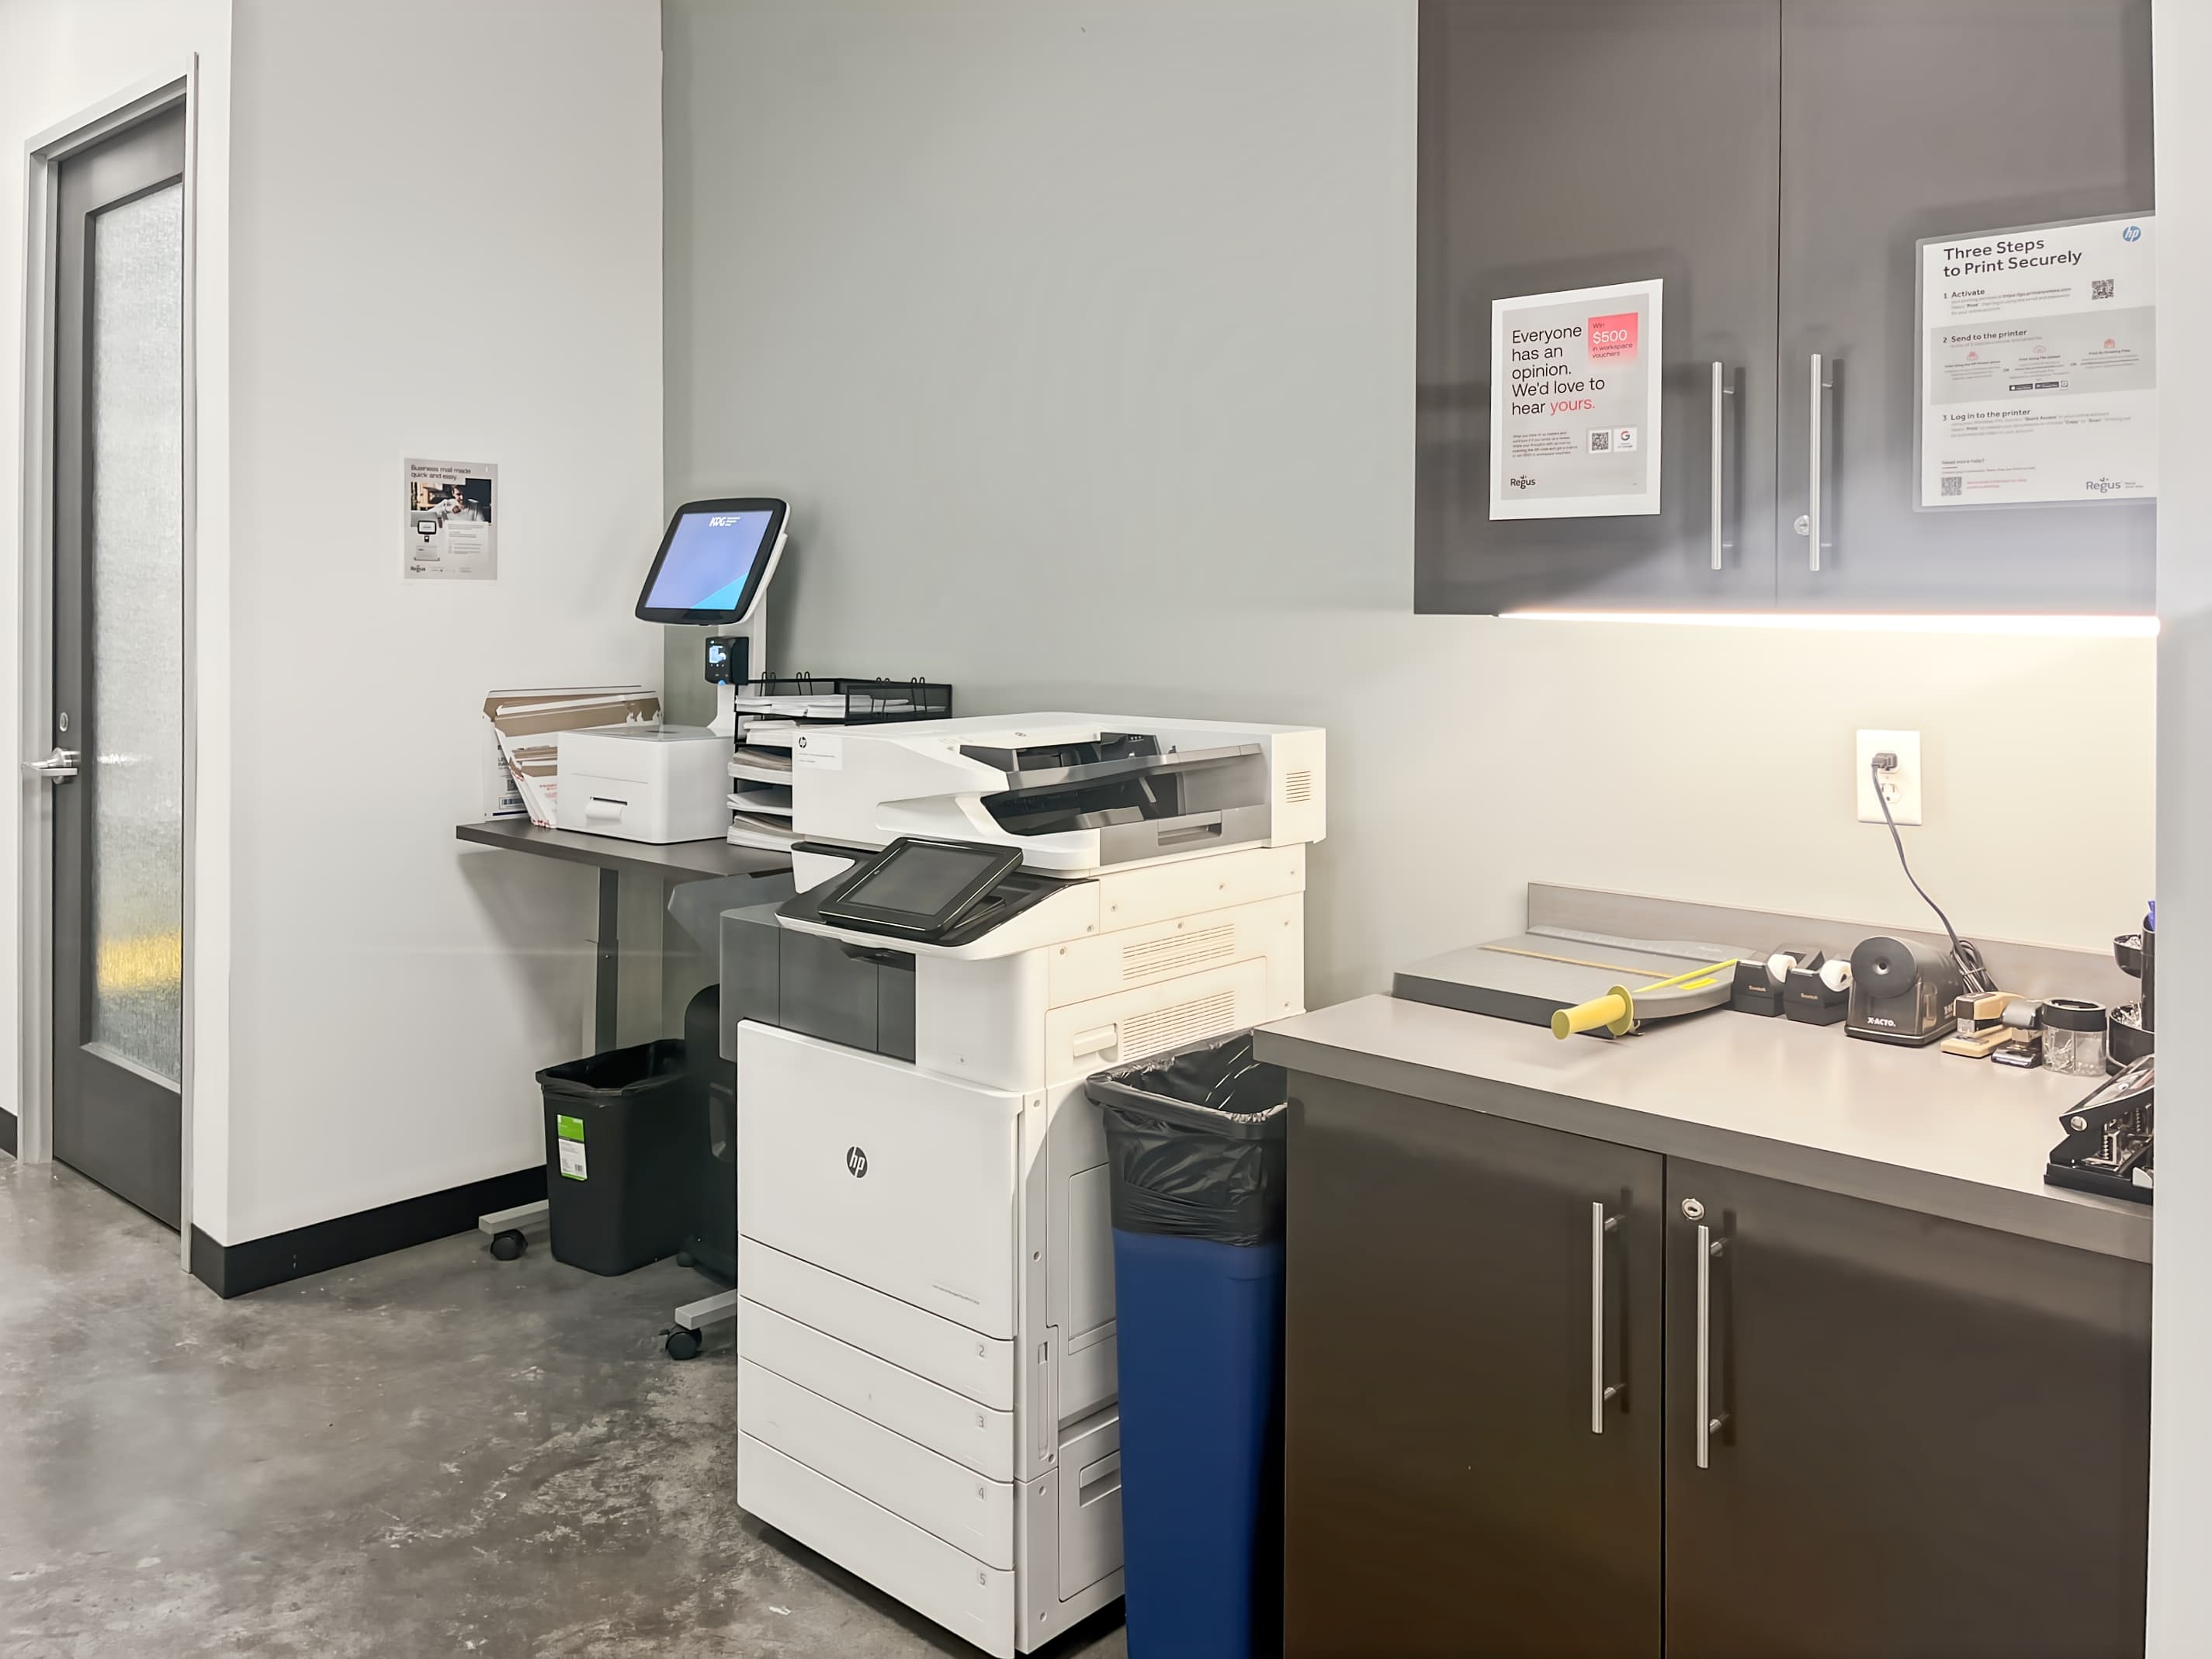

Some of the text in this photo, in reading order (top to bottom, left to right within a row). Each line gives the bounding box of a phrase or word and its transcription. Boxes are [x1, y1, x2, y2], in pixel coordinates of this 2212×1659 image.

[2123, 225, 2141, 242] hp
[1943, 239, 2044, 261] Three Steps
[1943, 250, 2082, 278] to Print Securely
[1950, 289, 1985, 299] Activate
[1512, 326, 1583, 344] Everyone
[1593, 329, 1628, 345] $500
[1951, 334, 1971, 343] Send
[1983, 331, 1997, 340] the
[1999, 329, 2027, 339] printer
[1512, 347, 1562, 362] has an
[1512, 362, 1572, 383] opinion.
[1511, 377, 1605, 397] We'd love to
[1512, 398, 1595, 416] hear yours.
[2002, 409, 2031, 418] printer
[1510, 474, 1537, 490] Regus
[2085, 476, 2121, 494] Regus
[847, 1146, 868, 1178] hp
[979, 1344, 985, 1358] 2
[978, 1415, 984, 1428] 3
[978, 1488, 984, 1500] 4
[979, 1573, 986, 1586] 5
